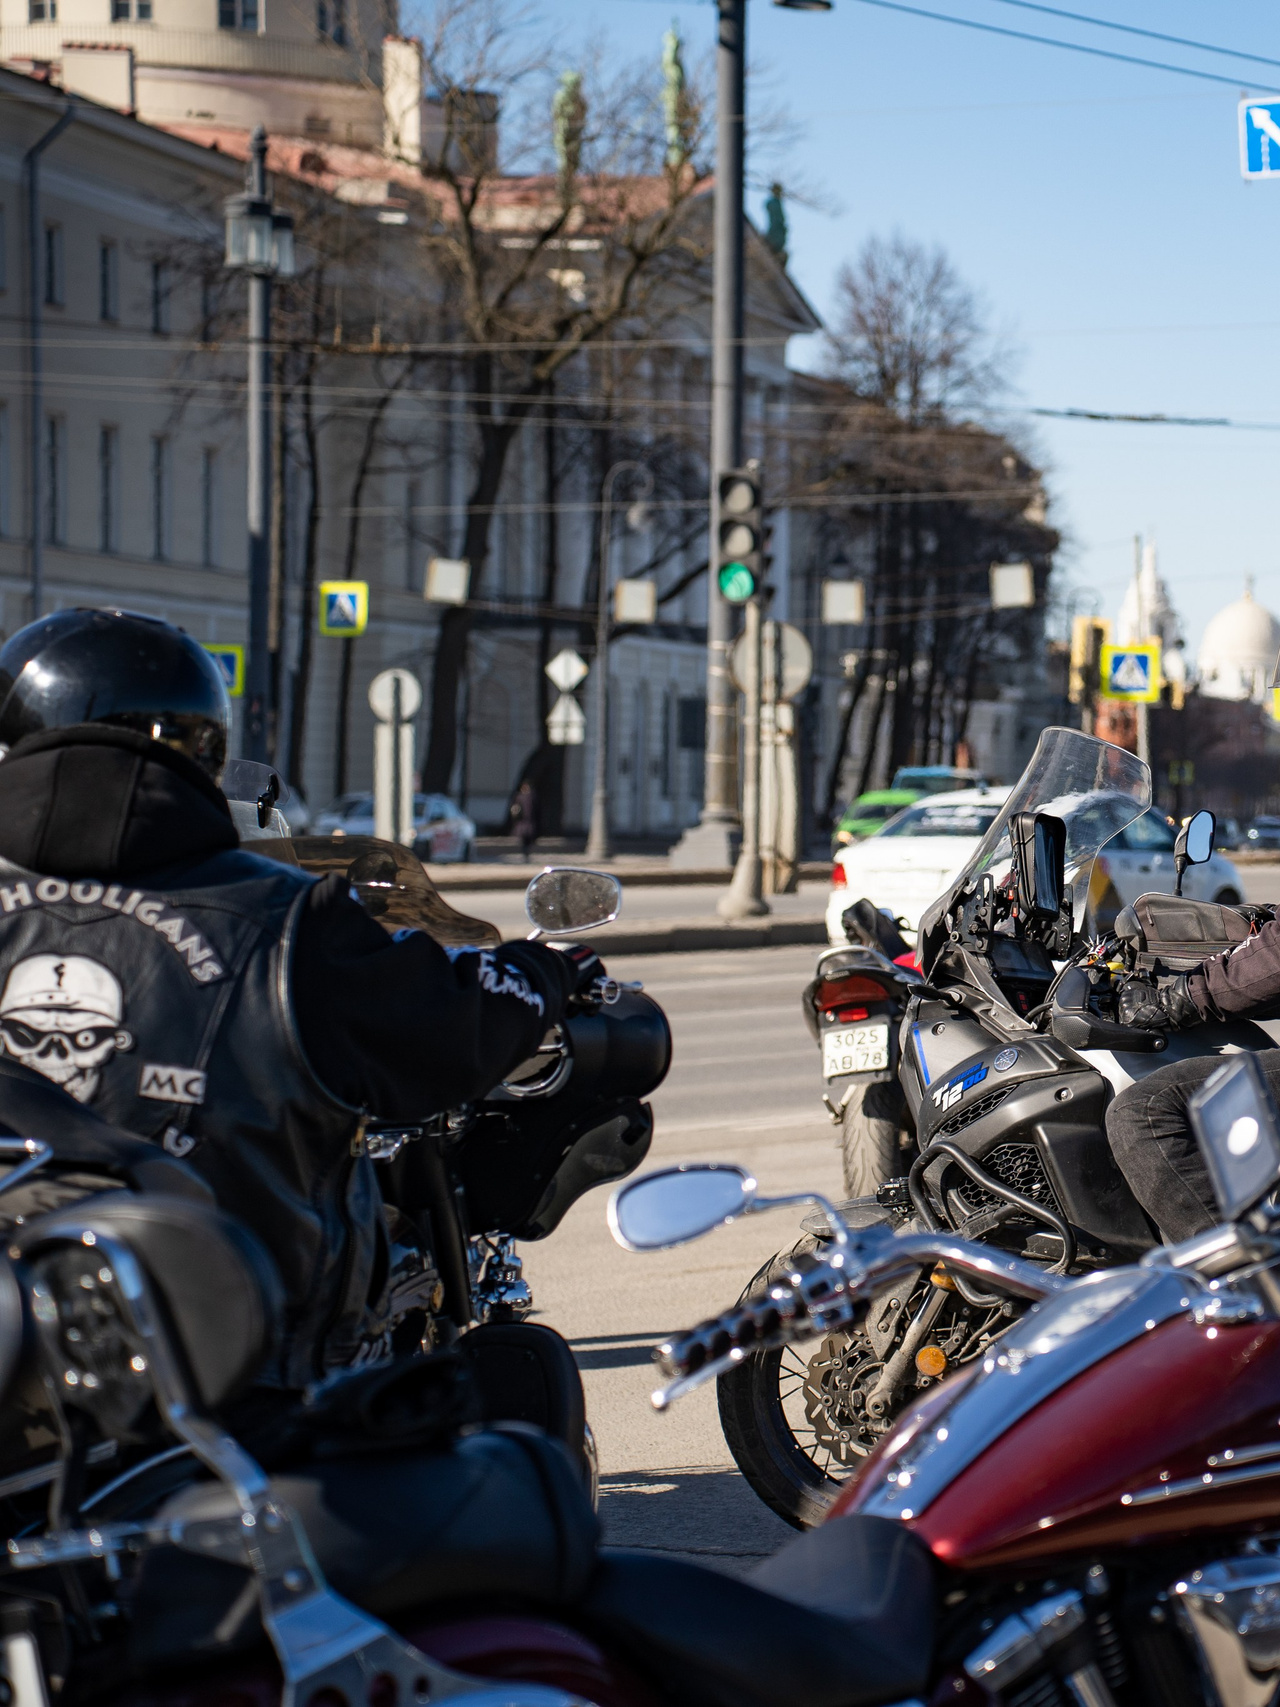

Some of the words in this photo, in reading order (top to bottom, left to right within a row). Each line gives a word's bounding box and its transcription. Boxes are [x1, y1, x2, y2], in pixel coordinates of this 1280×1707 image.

[0, 878, 223, 983] HOOLIGANS
[832, 1029, 879, 1049] 3025
[860, 1051, 882, 1067] 78
[144, 1070, 204, 1098] MC
